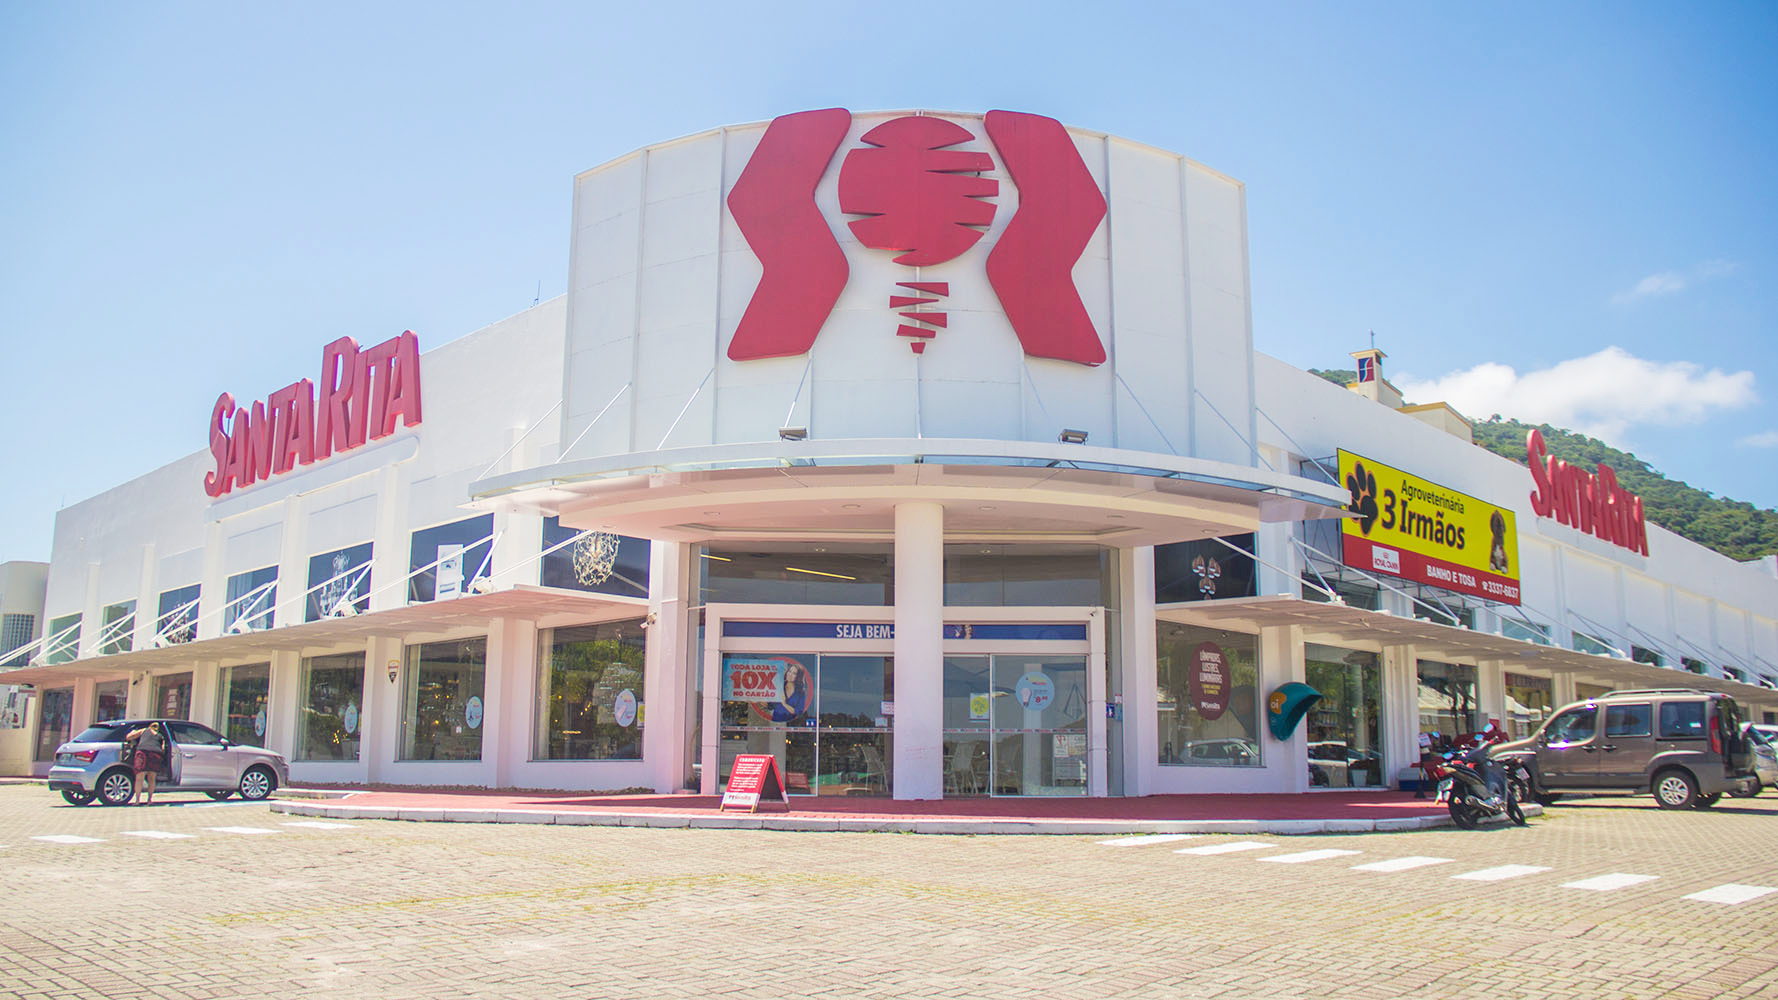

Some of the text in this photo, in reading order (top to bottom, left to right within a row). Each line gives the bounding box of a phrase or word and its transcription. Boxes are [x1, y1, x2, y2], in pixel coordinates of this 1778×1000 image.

[1401, 479, 1465, 514] Agroveterinária
[1382, 488, 1465, 550] 3 Irmãos
[1426, 564, 1451, 581] BANHO
[1452, 571, 1458, 583] E
[1458, 573, 1477, 588] TOSA
[836, 624, 862, 638] SEJA
[730, 671, 777, 690] 10X
